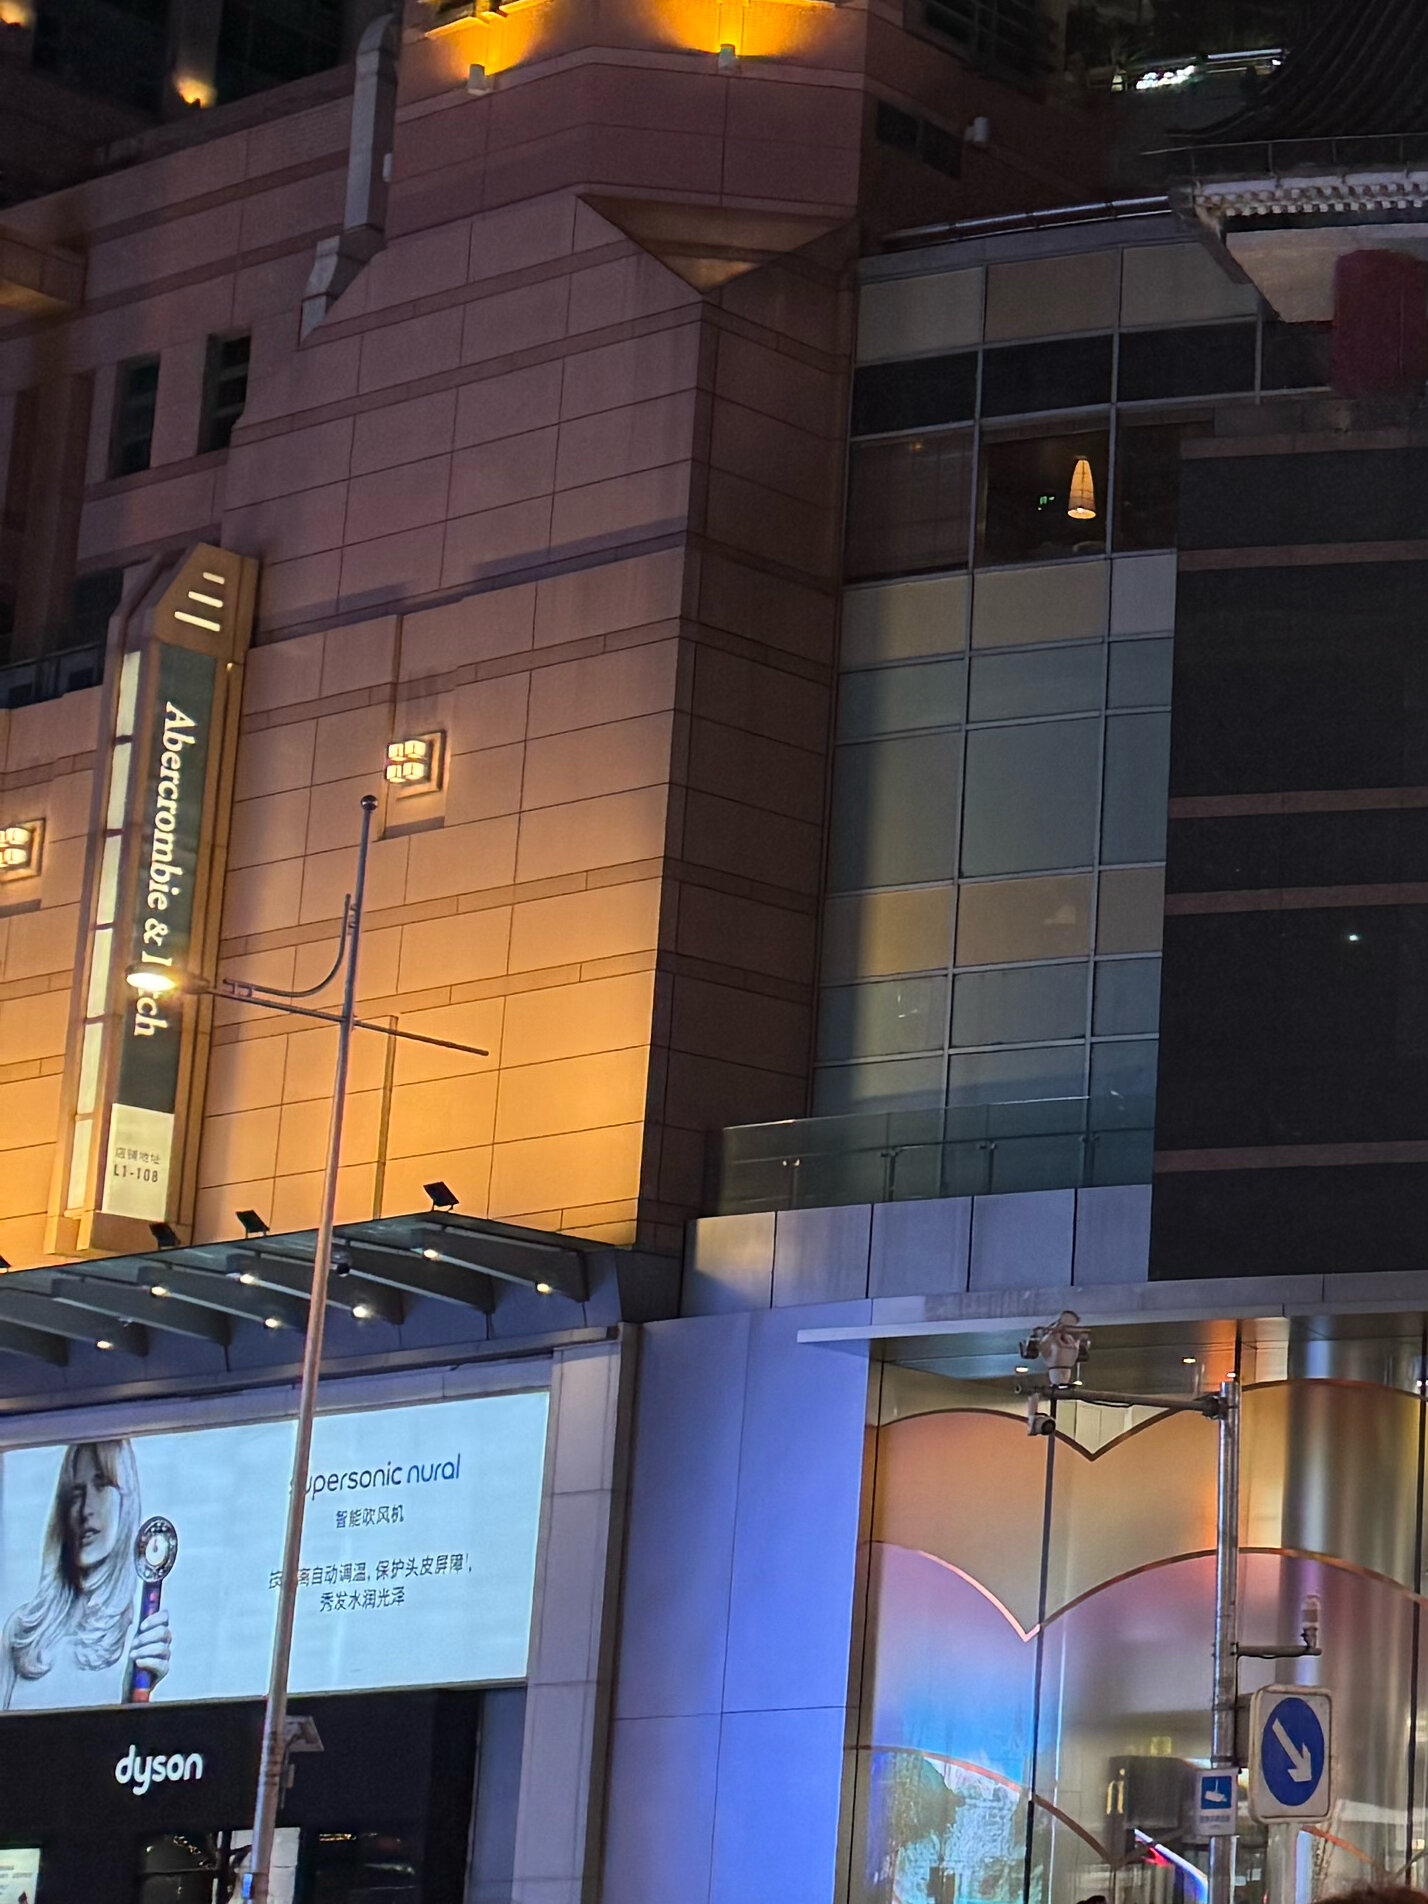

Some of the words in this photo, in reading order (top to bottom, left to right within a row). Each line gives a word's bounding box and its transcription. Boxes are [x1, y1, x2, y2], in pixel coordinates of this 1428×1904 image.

[148, 701, 198, 911] Abercrombie
[143, 917, 169, 947] &
[113, 1164, 159, 1183] L1-108
[289, 1460, 402, 1501] upersonic
[406, 1452, 461, 1484] nural
[336, 1504, 405, 1529] 智能吹风机
[319, 1585, 406, 1613] 秀发水润光泽
[115, 1744, 204, 1796] dyson
